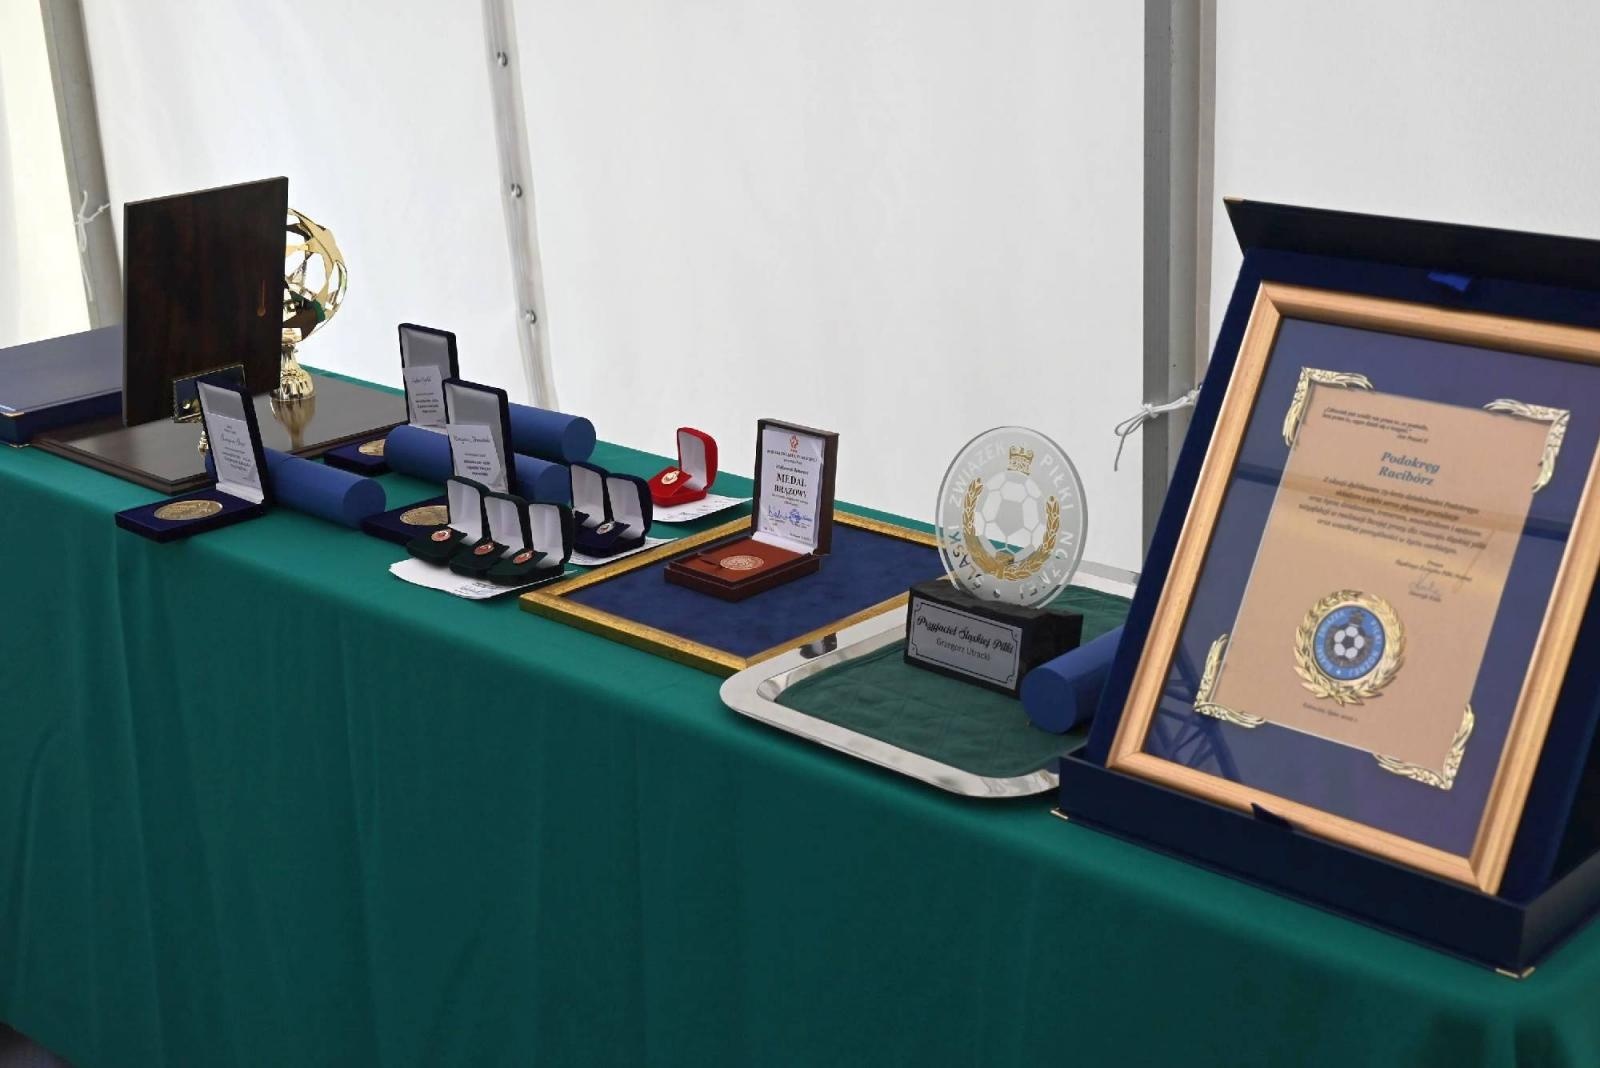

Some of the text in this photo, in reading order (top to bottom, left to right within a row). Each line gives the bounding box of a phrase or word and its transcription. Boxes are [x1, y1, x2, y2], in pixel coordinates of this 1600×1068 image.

[1380, 451, 1440, 473] Podokręg
[776, 473, 807, 487] MEDAL
[1040, 455, 1074, 510] PIŁKI
[1378, 465, 1435, 486] Racibórz
[774, 484, 807, 498] BRĄZOWY
[917, 615, 1014, 655] Przyjaciel Śląskiej Piłki
[936, 638, 991, 662] Grzegorz Utracki
